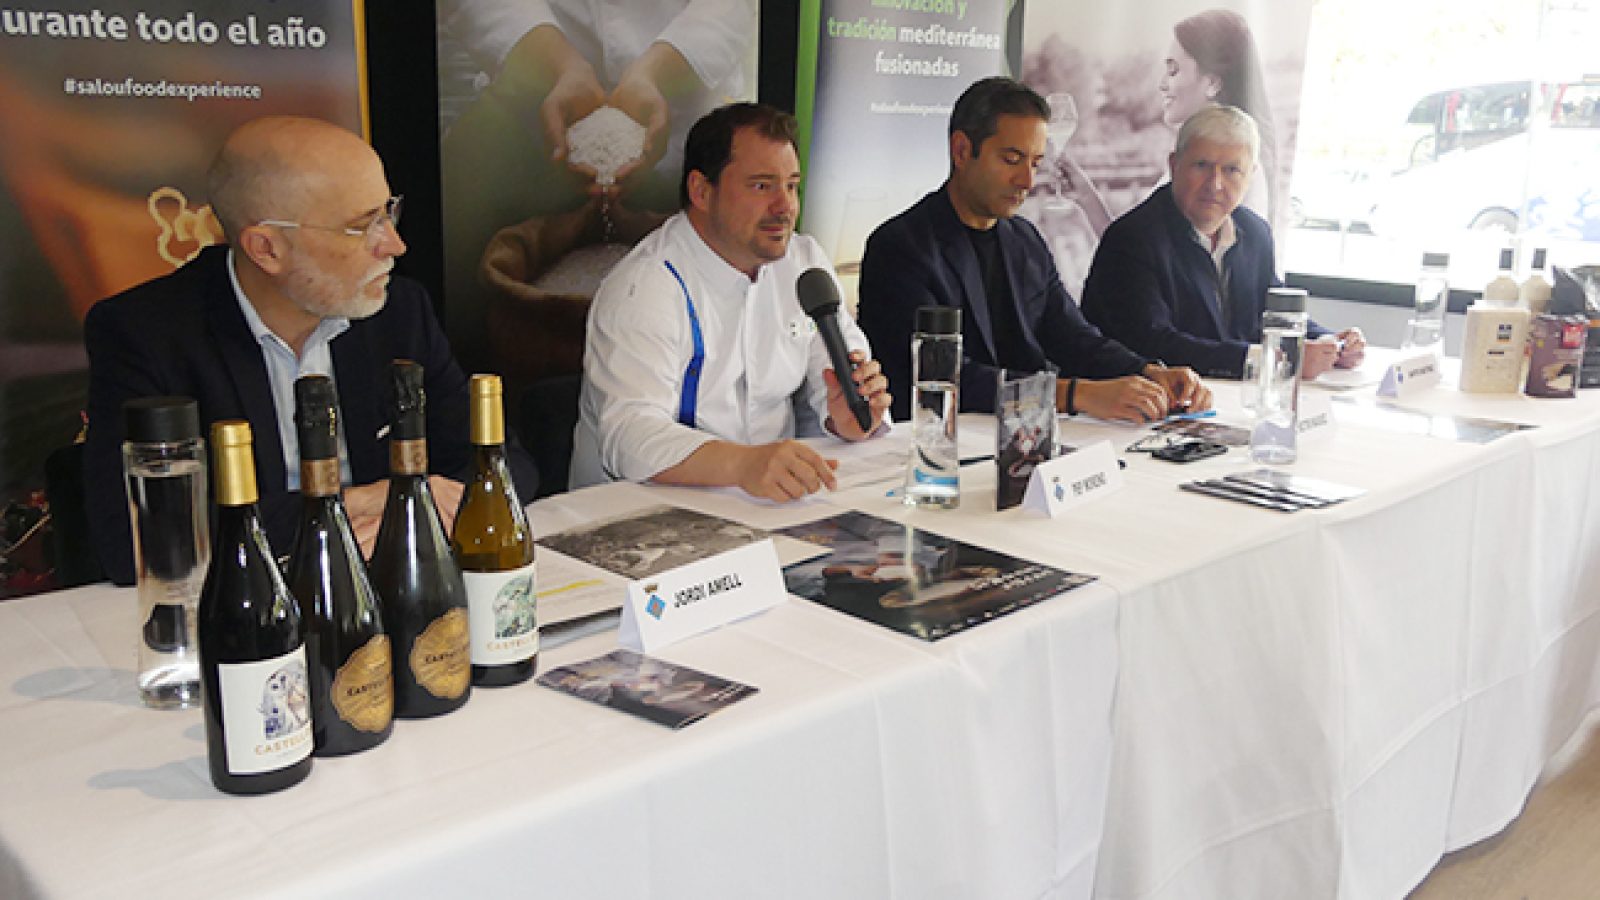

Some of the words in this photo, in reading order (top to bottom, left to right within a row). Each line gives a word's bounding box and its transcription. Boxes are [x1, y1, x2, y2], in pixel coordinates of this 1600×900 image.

[0, 9, 129, 40] urante
[136, 12, 219, 44] todo
[228, 15, 260, 45] el
[267, 17, 327, 49] año
[827, 17, 897, 41] tradición
[900, 24, 1001, 50] mediterránea
[875, 50, 960, 77] fusionadas
[64, 77, 262, 101] #saloufoodexperience
